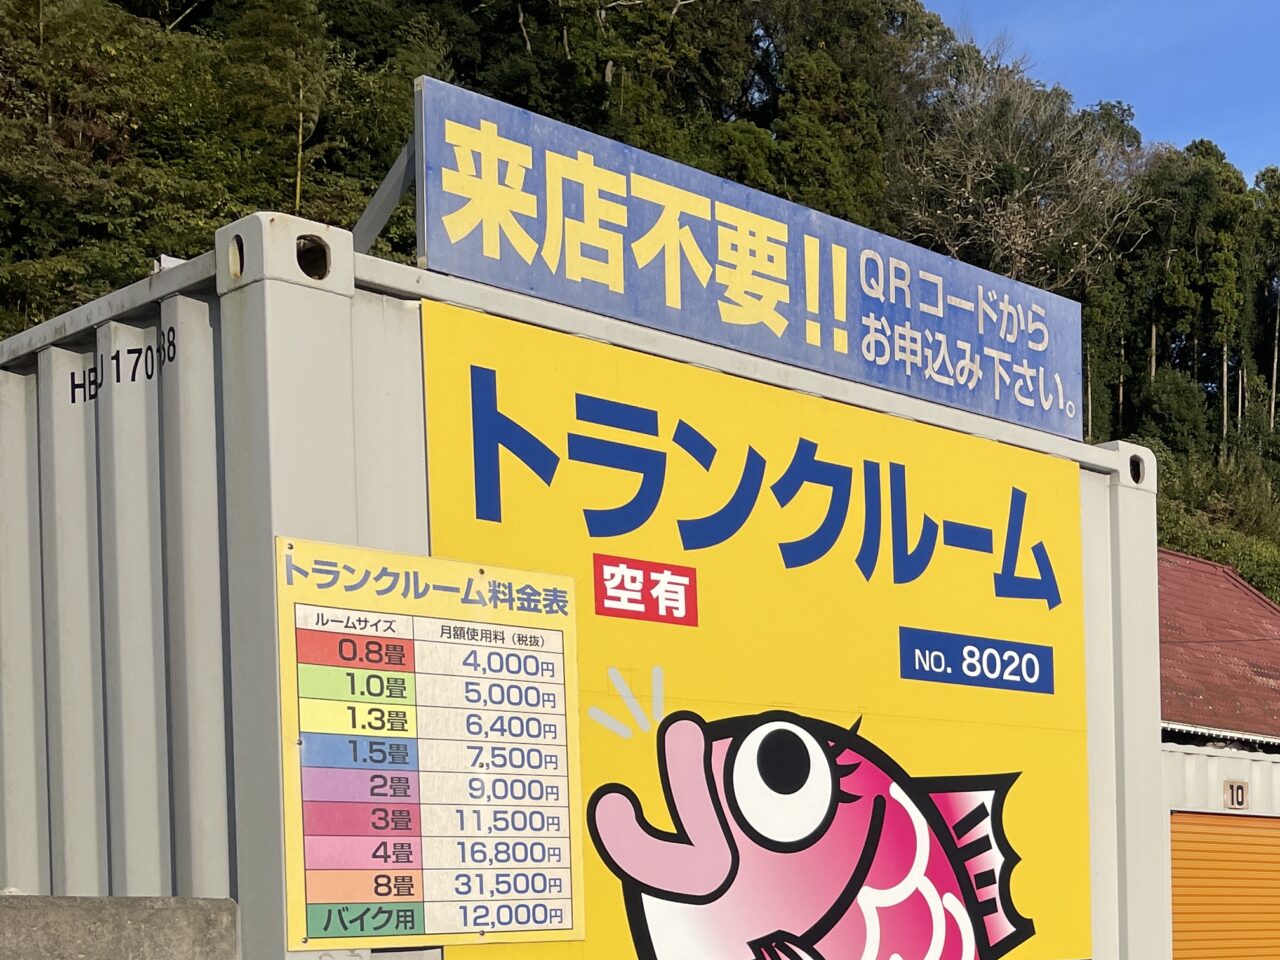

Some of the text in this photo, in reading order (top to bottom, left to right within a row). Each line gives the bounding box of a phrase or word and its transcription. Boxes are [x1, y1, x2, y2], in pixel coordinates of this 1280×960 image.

[861, 314, 1075, 418] お申込み下さい。
[470, 364, 1062, 611] トランクルーム
[285, 553, 569, 616] トランクルーム料金表
[602, 562, 690, 618] 空有
[315, 613, 397, 633] ルームサイズ
[338, 638, 405, 666] 0.8畳
[914, 645, 1040, 684] NO. 8020
[462, 652, 555, 679] 4,000円
[346, 672, 408, 699] 1.0畳
[464, 683, 557, 709] 5,000円
[347, 706, 409, 732] 1.3畳
[466, 714, 558, 740] 6,400円
[349, 739, 409, 766] 1.5畳
[467, 745, 559, 770] 7,500円
[370, 775, 411, 799] 2畳
[468, 778, 560, 802] 9,000円
[1229, 784, 1245, 806] 10
[371, 808, 412, 832] 3畳
[455, 809, 561, 833] 11,500円
[372, 841, 413, 865] 4畳
[457, 841, 562, 865] 16,800円
[373, 874, 415, 898] 8畳
[454, 873, 563, 898] 31,500円
[323, 906, 416, 933] バイク用
[459, 904, 564, 929] 12,000円
